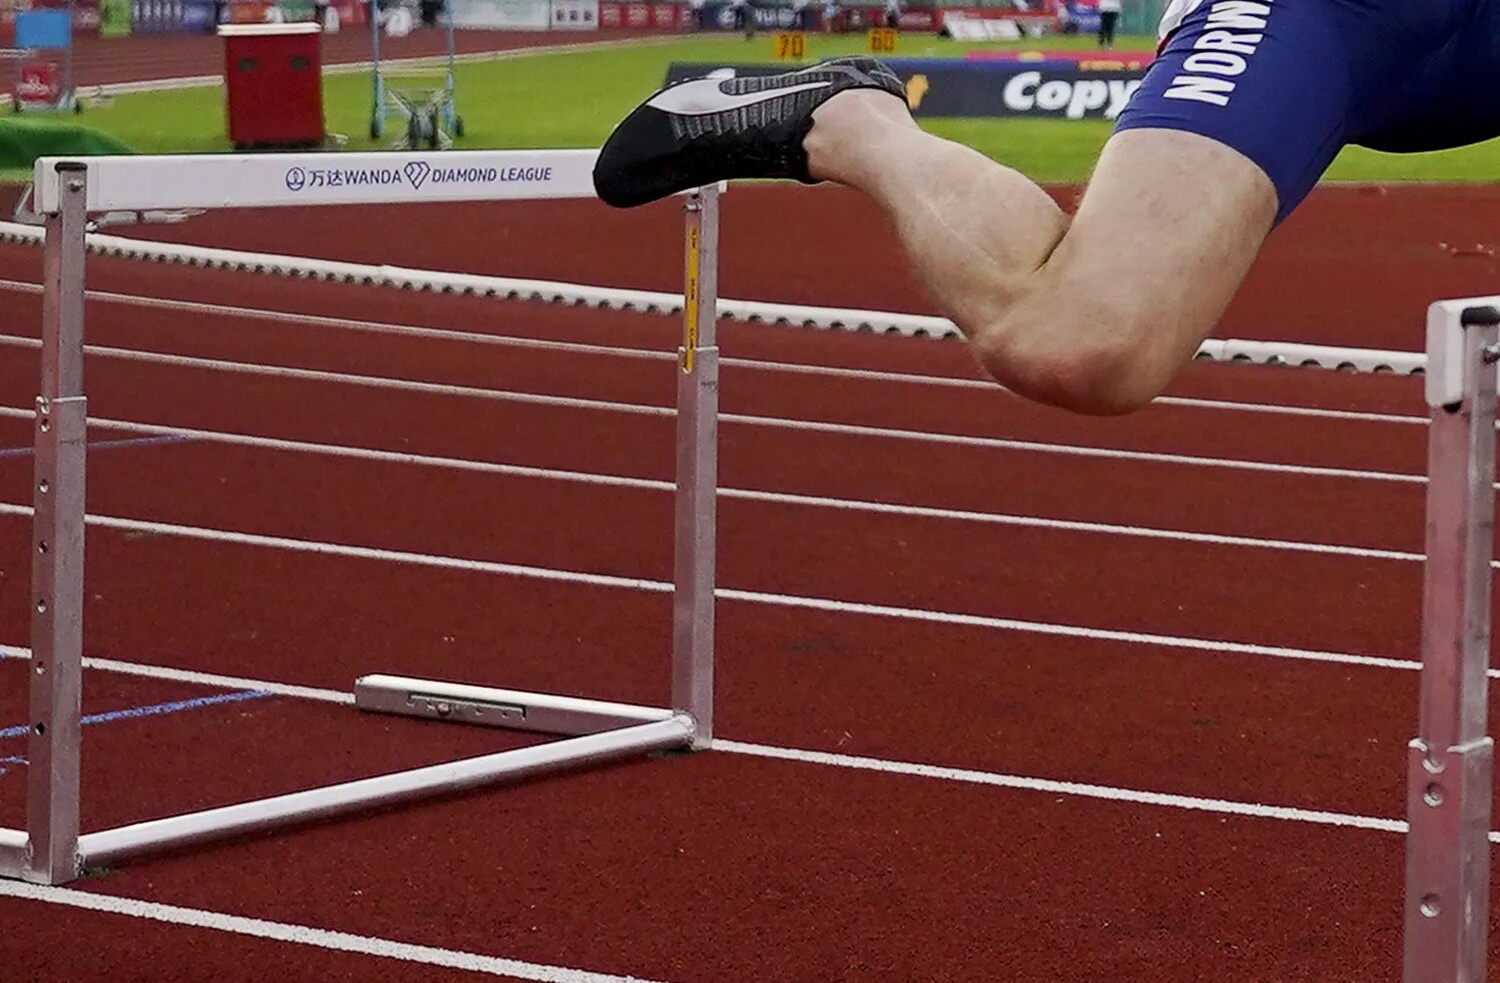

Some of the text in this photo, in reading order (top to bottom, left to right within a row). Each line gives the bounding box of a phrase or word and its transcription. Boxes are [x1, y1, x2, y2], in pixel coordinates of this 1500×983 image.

[309, 166, 552, 187] 万达 WANDA DIAMOND LEAGUE
